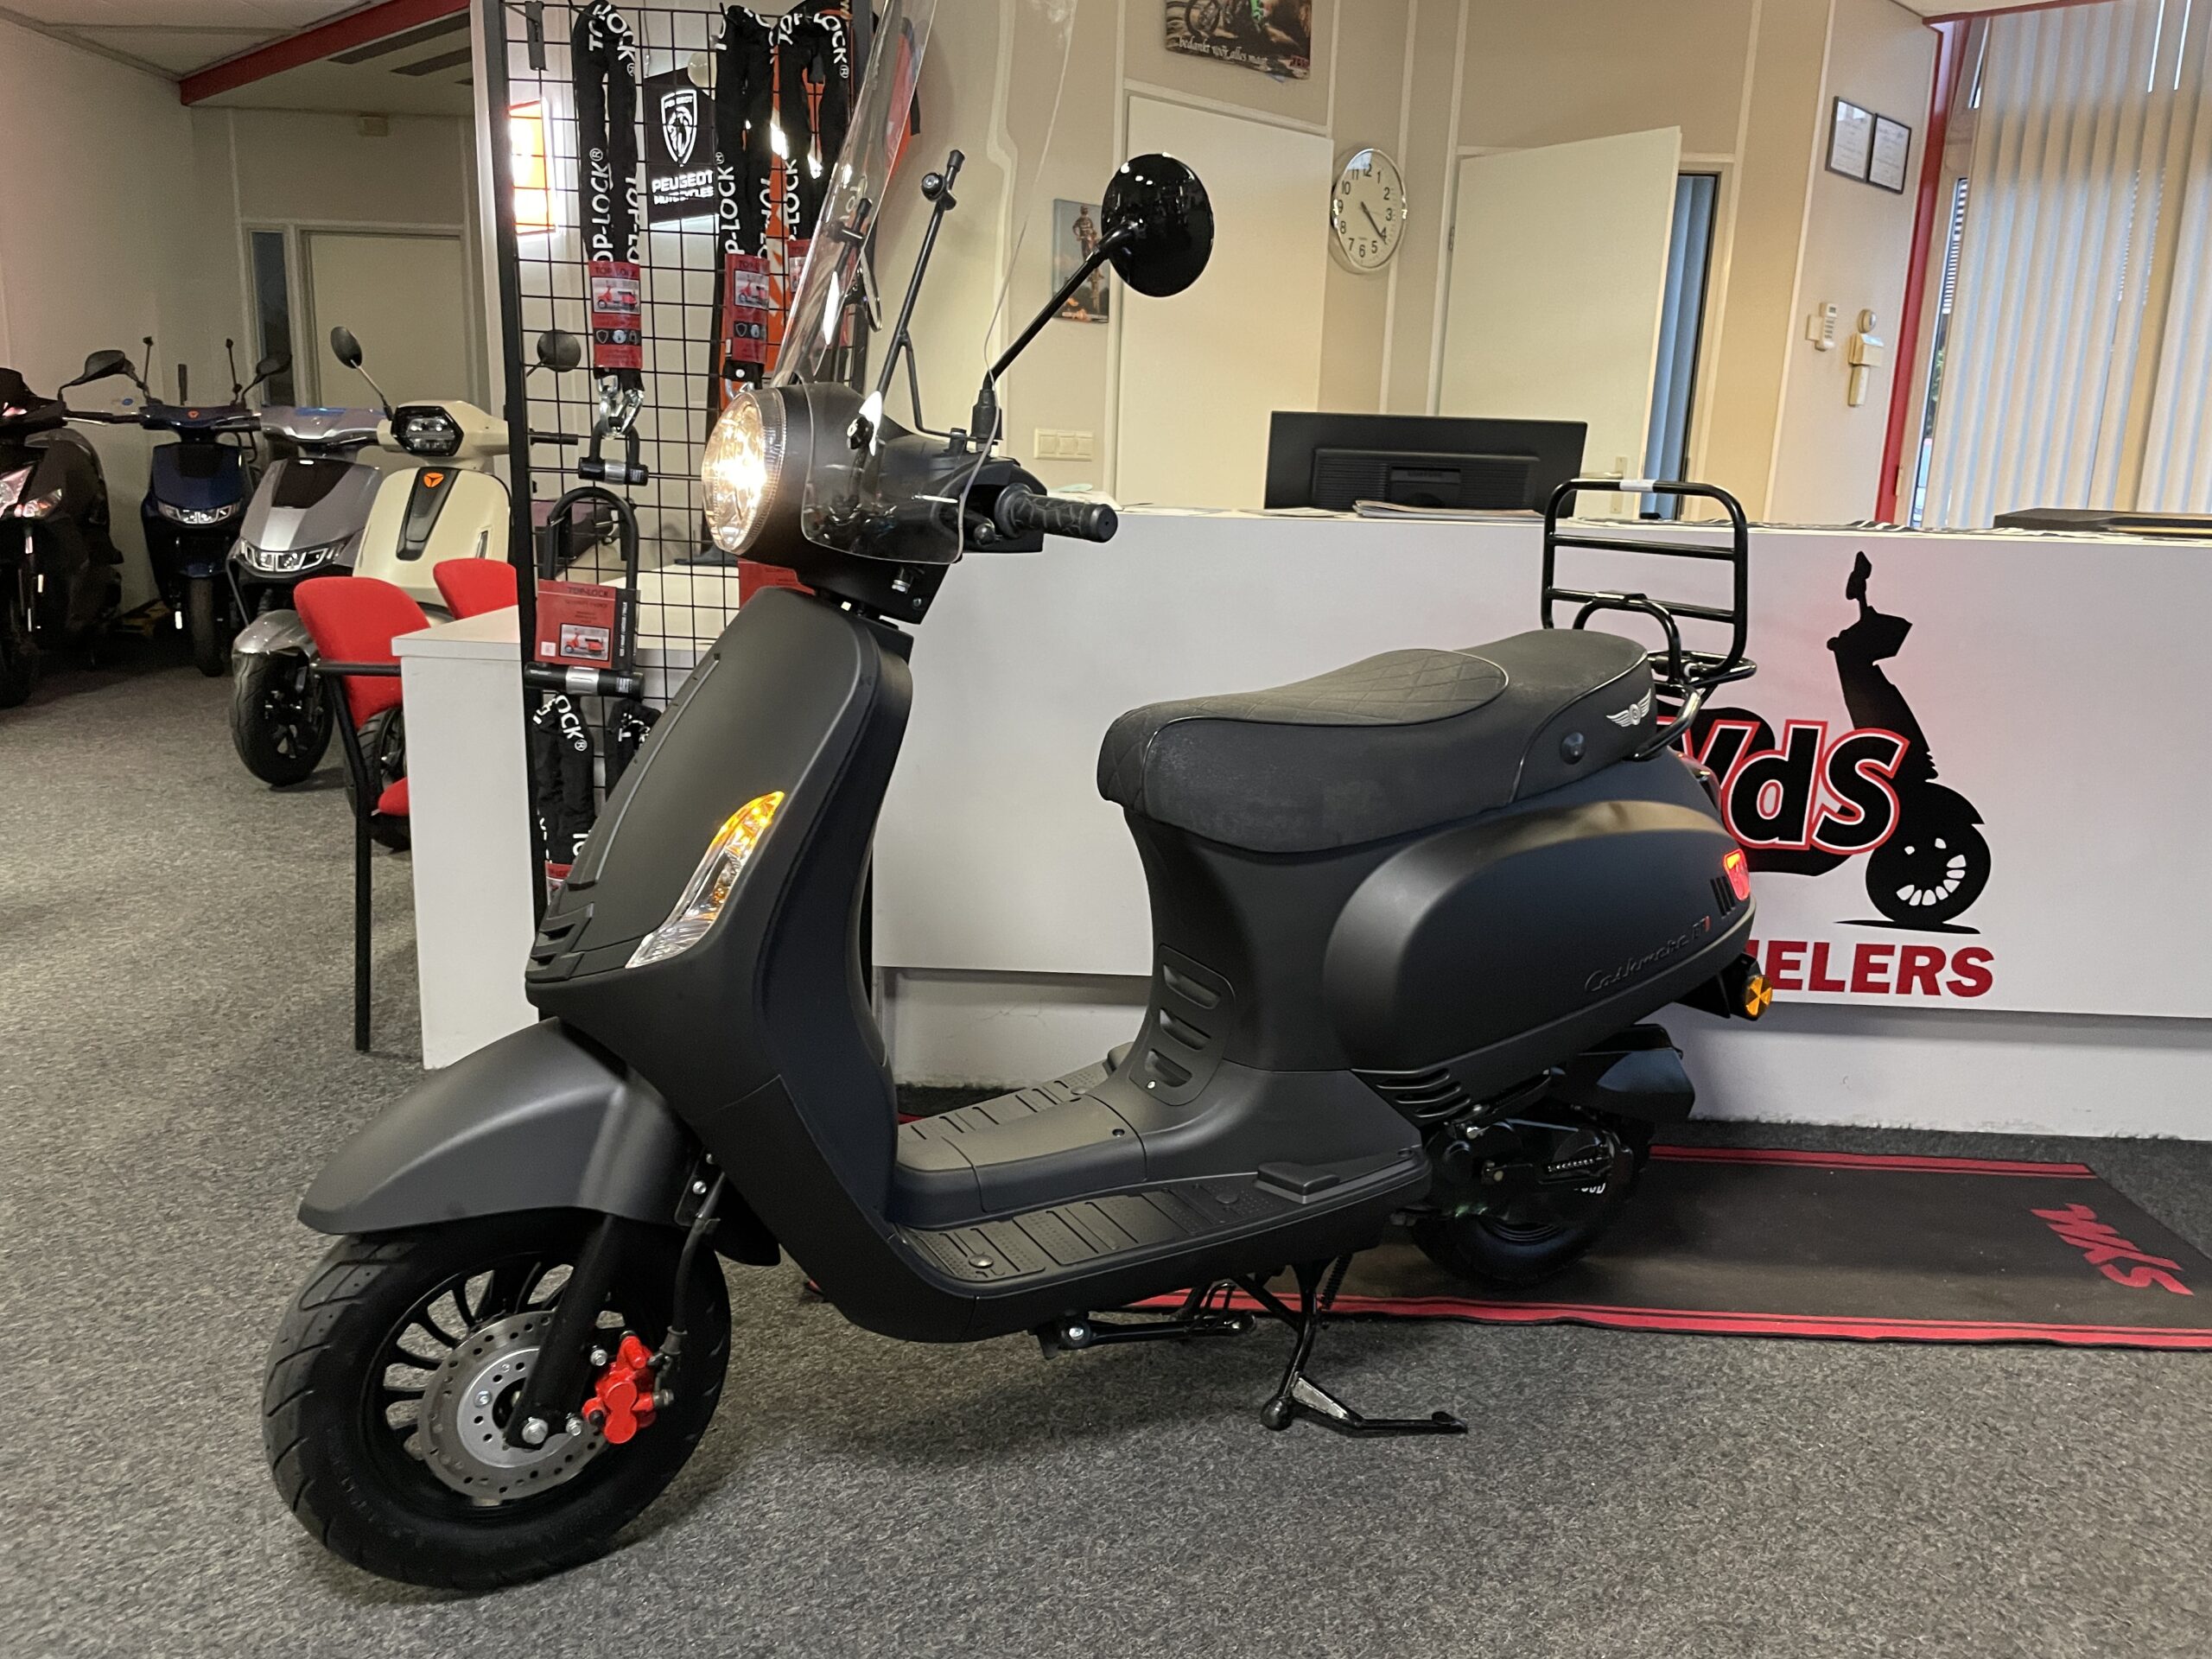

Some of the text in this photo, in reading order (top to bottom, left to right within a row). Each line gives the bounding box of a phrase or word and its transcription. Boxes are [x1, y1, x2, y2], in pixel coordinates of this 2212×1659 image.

[1351, 168, 1359, 180] 11
[1363, 163, 1372, 177] 12
[652, 169, 714, 193] PEUGEOT
[1342, 180, 1351, 195] 10
[1383, 187, 1390, 200] 2
[1386, 207, 1393, 221] 3
[1340, 220, 1346, 234] 8
[1381, 227, 1387, 241] 4
[1348, 237, 1355, 251] 7
[1359, 245, 1365, 257] 6
[1371, 240, 1378, 253] 5
